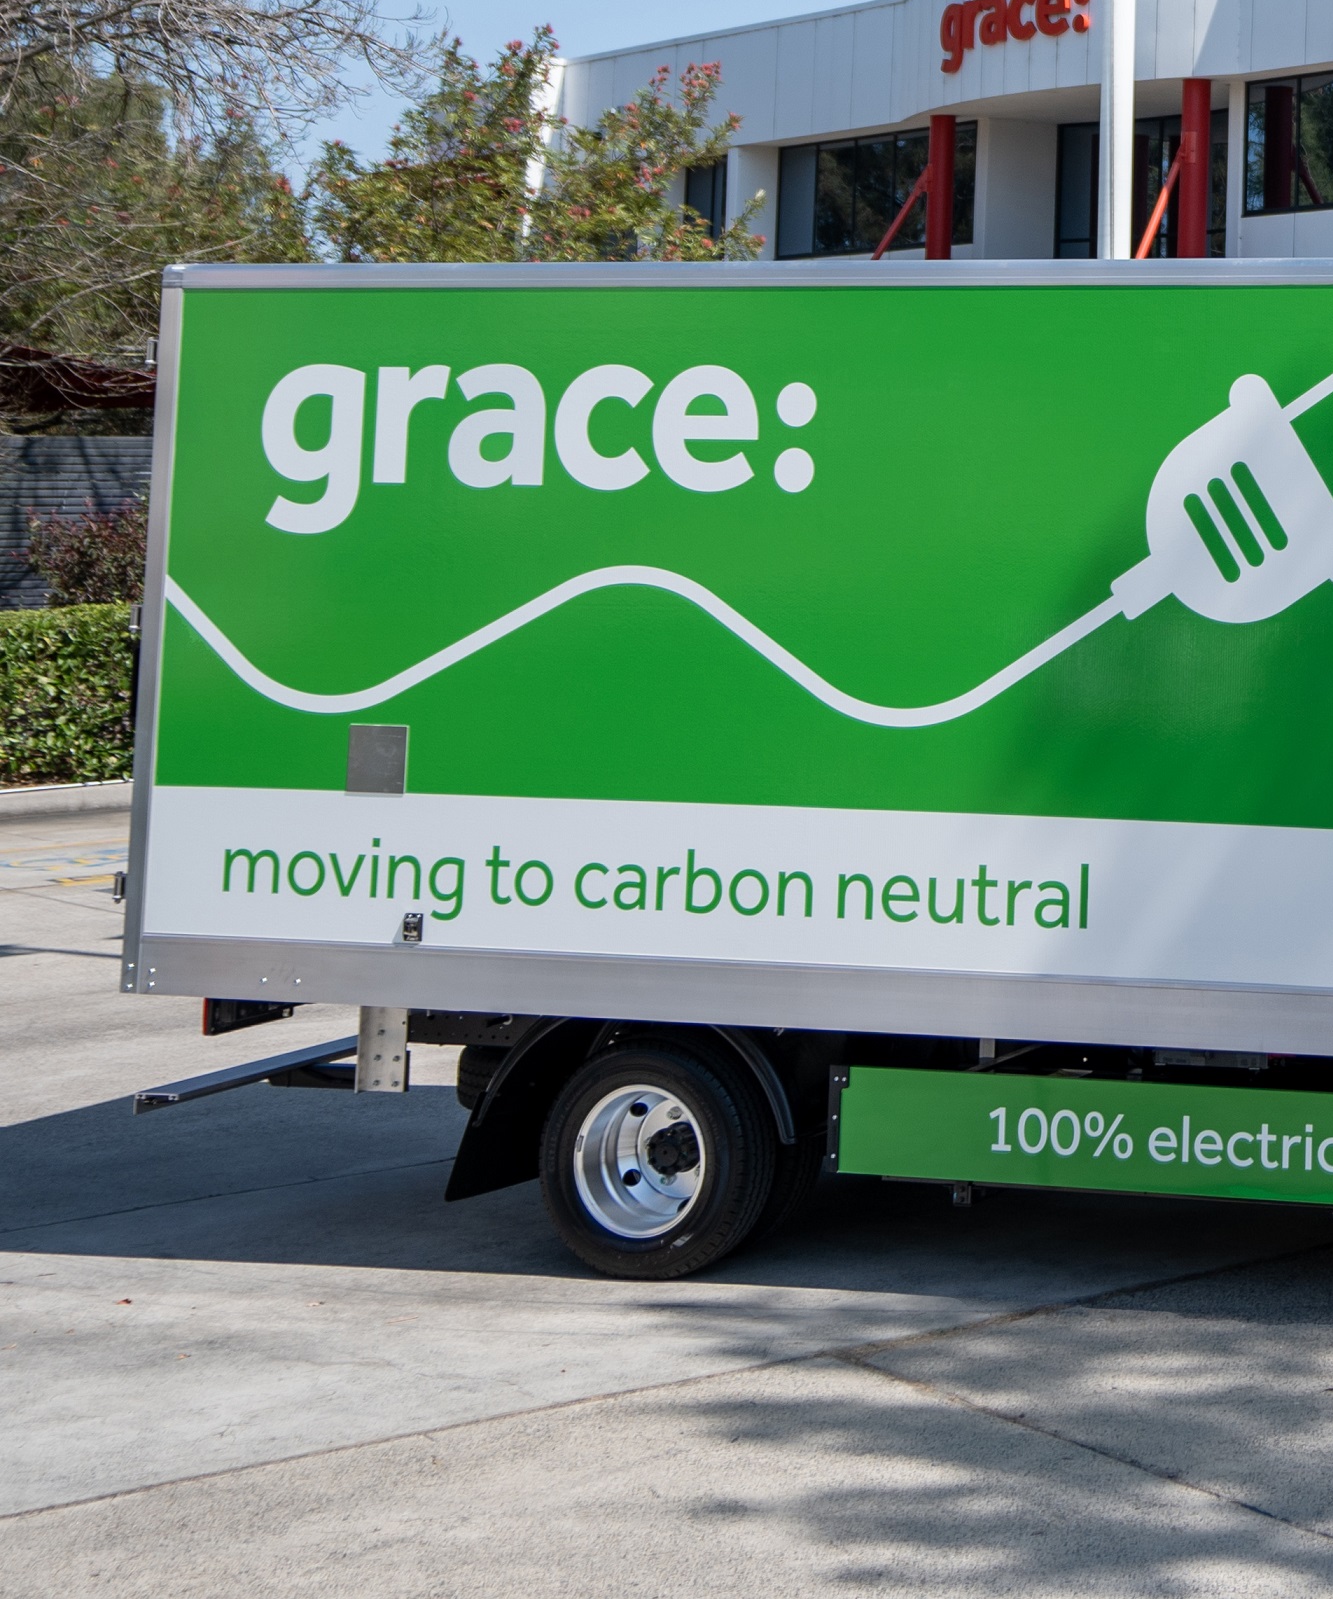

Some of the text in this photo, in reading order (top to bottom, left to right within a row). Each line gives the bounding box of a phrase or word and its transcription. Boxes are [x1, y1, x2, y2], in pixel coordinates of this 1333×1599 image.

[262, 363, 818, 534] grace:
[222, 838, 1090, 929] moving to carbon neutral
[988, 1106, 1134, 1159] 100%
